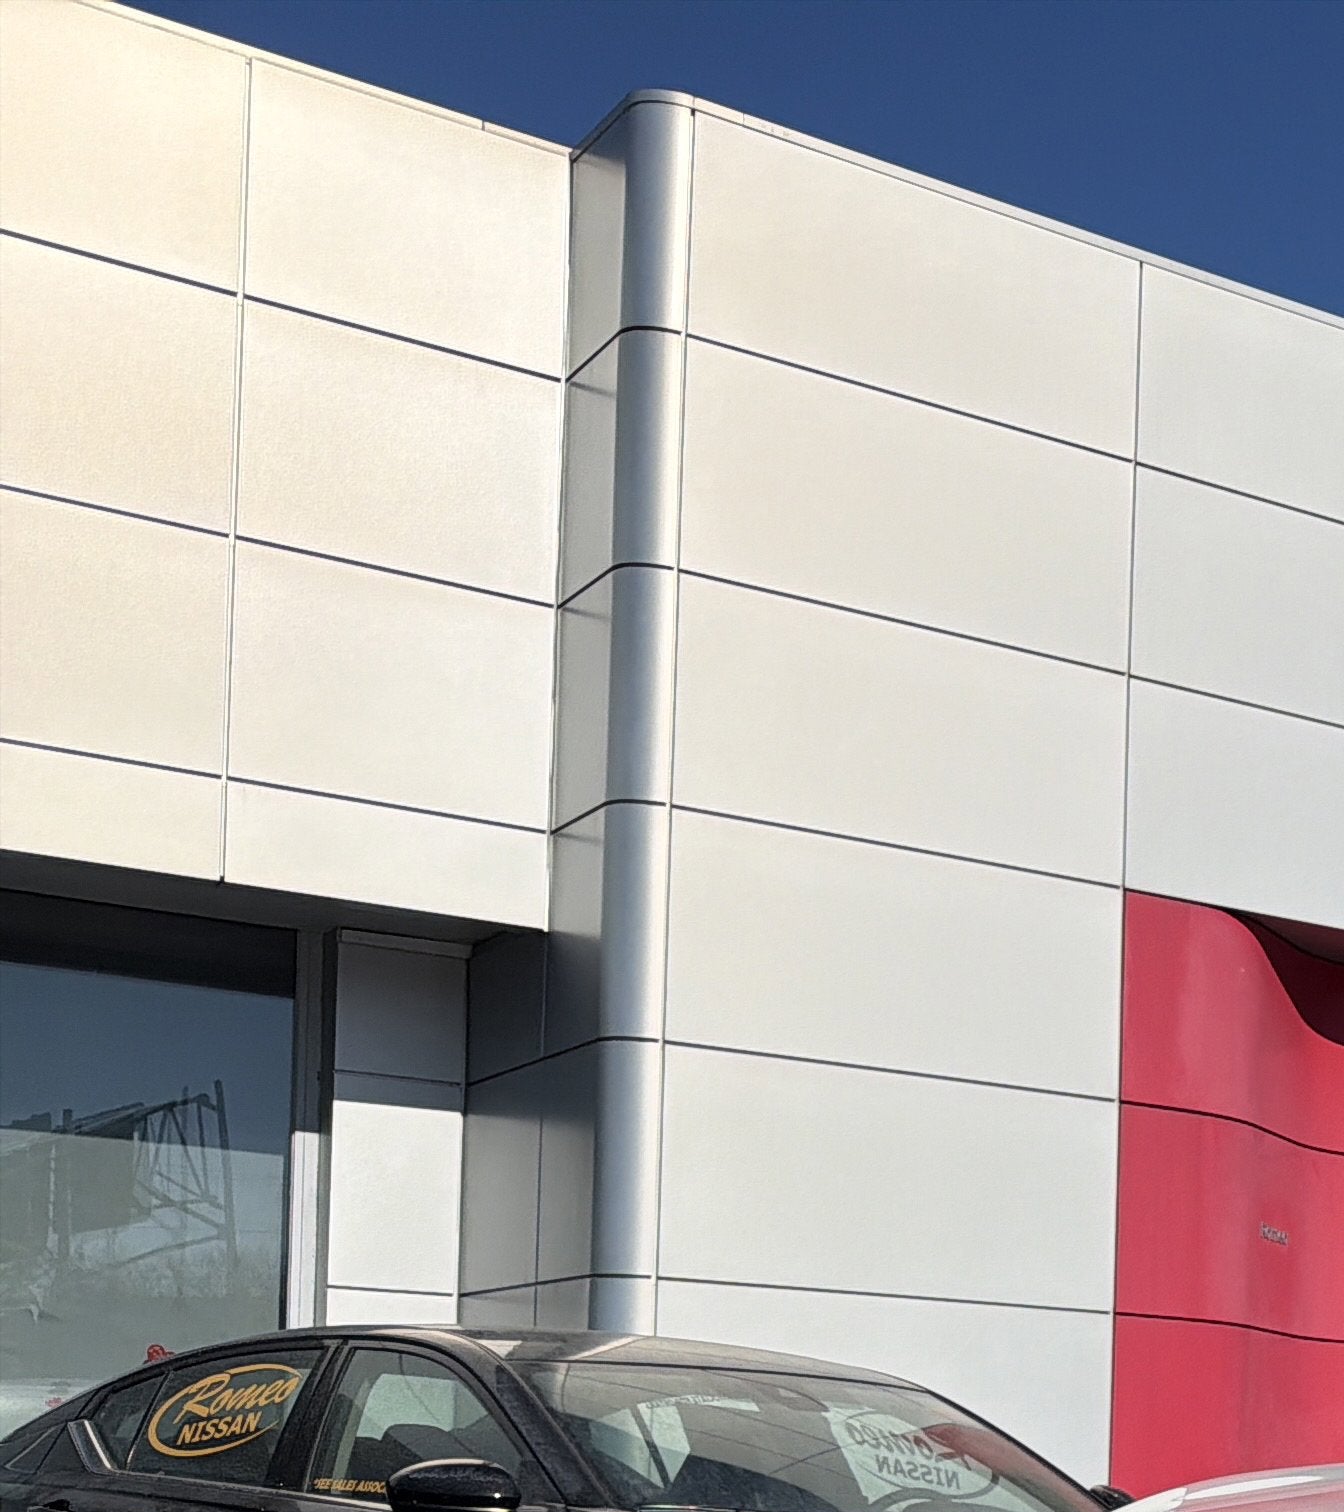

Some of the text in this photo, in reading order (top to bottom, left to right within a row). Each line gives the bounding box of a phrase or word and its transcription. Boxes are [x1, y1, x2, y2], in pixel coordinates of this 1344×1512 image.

[173, 1371, 300, 1425] Romeo
[176, 1411, 262, 1446] NISSAN
[331, 1478, 357, 1492] SALES
[357, 1481, 387, 1494] ASSOC
